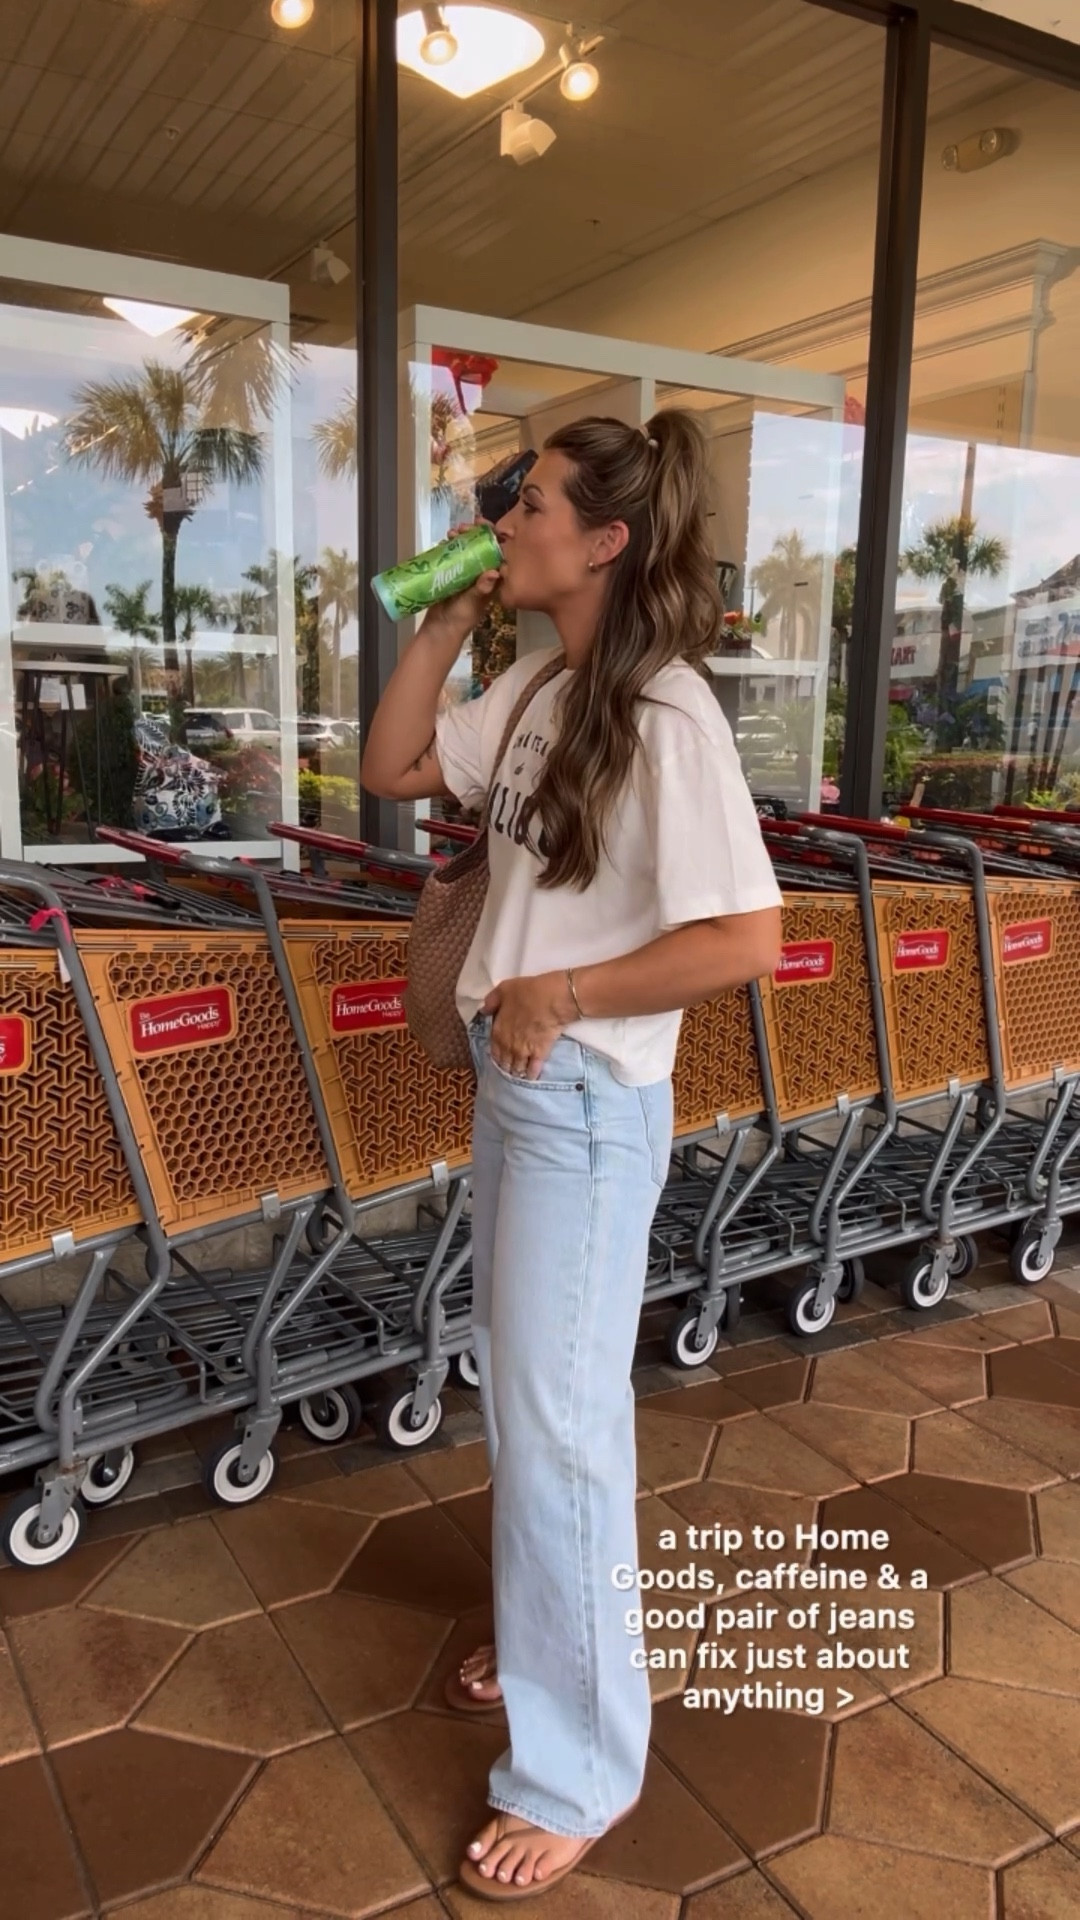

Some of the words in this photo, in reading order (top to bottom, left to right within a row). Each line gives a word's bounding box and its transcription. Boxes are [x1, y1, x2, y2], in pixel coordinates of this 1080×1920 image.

[897, 943, 939, 957] HomeGoods
[1003, 935, 1043, 953] HomeGoods
[778, 956, 825, 971] HomeGoods
[336, 996, 402, 1017] HomeGoods
[140, 1006, 220, 1038] HomeGoods
